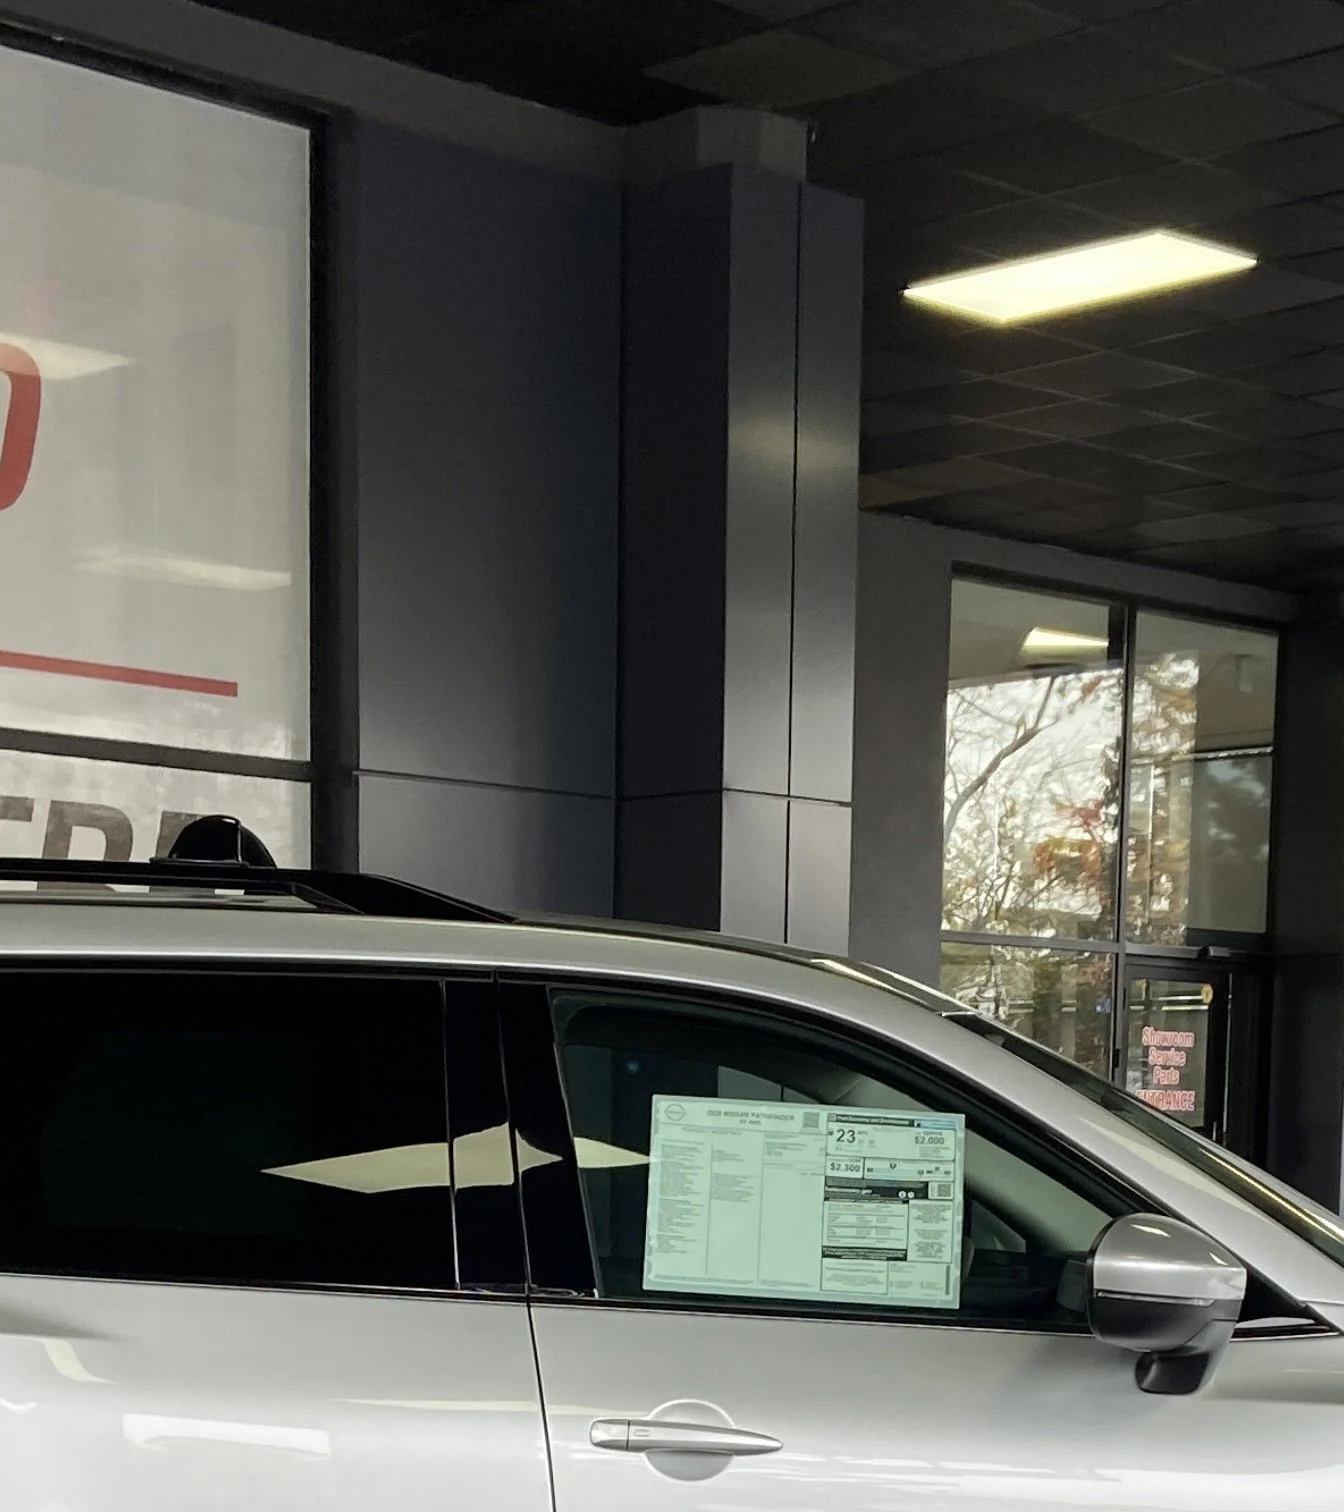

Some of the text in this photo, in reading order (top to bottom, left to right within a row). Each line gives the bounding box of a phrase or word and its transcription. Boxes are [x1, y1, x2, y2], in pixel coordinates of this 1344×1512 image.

[1142, 1026, 1195, 1047] Showroom
[1148, 1046, 1187, 1067] Service
[1152, 1065, 1180, 1085] Parts
[835, 1128, 857, 1144] 23
